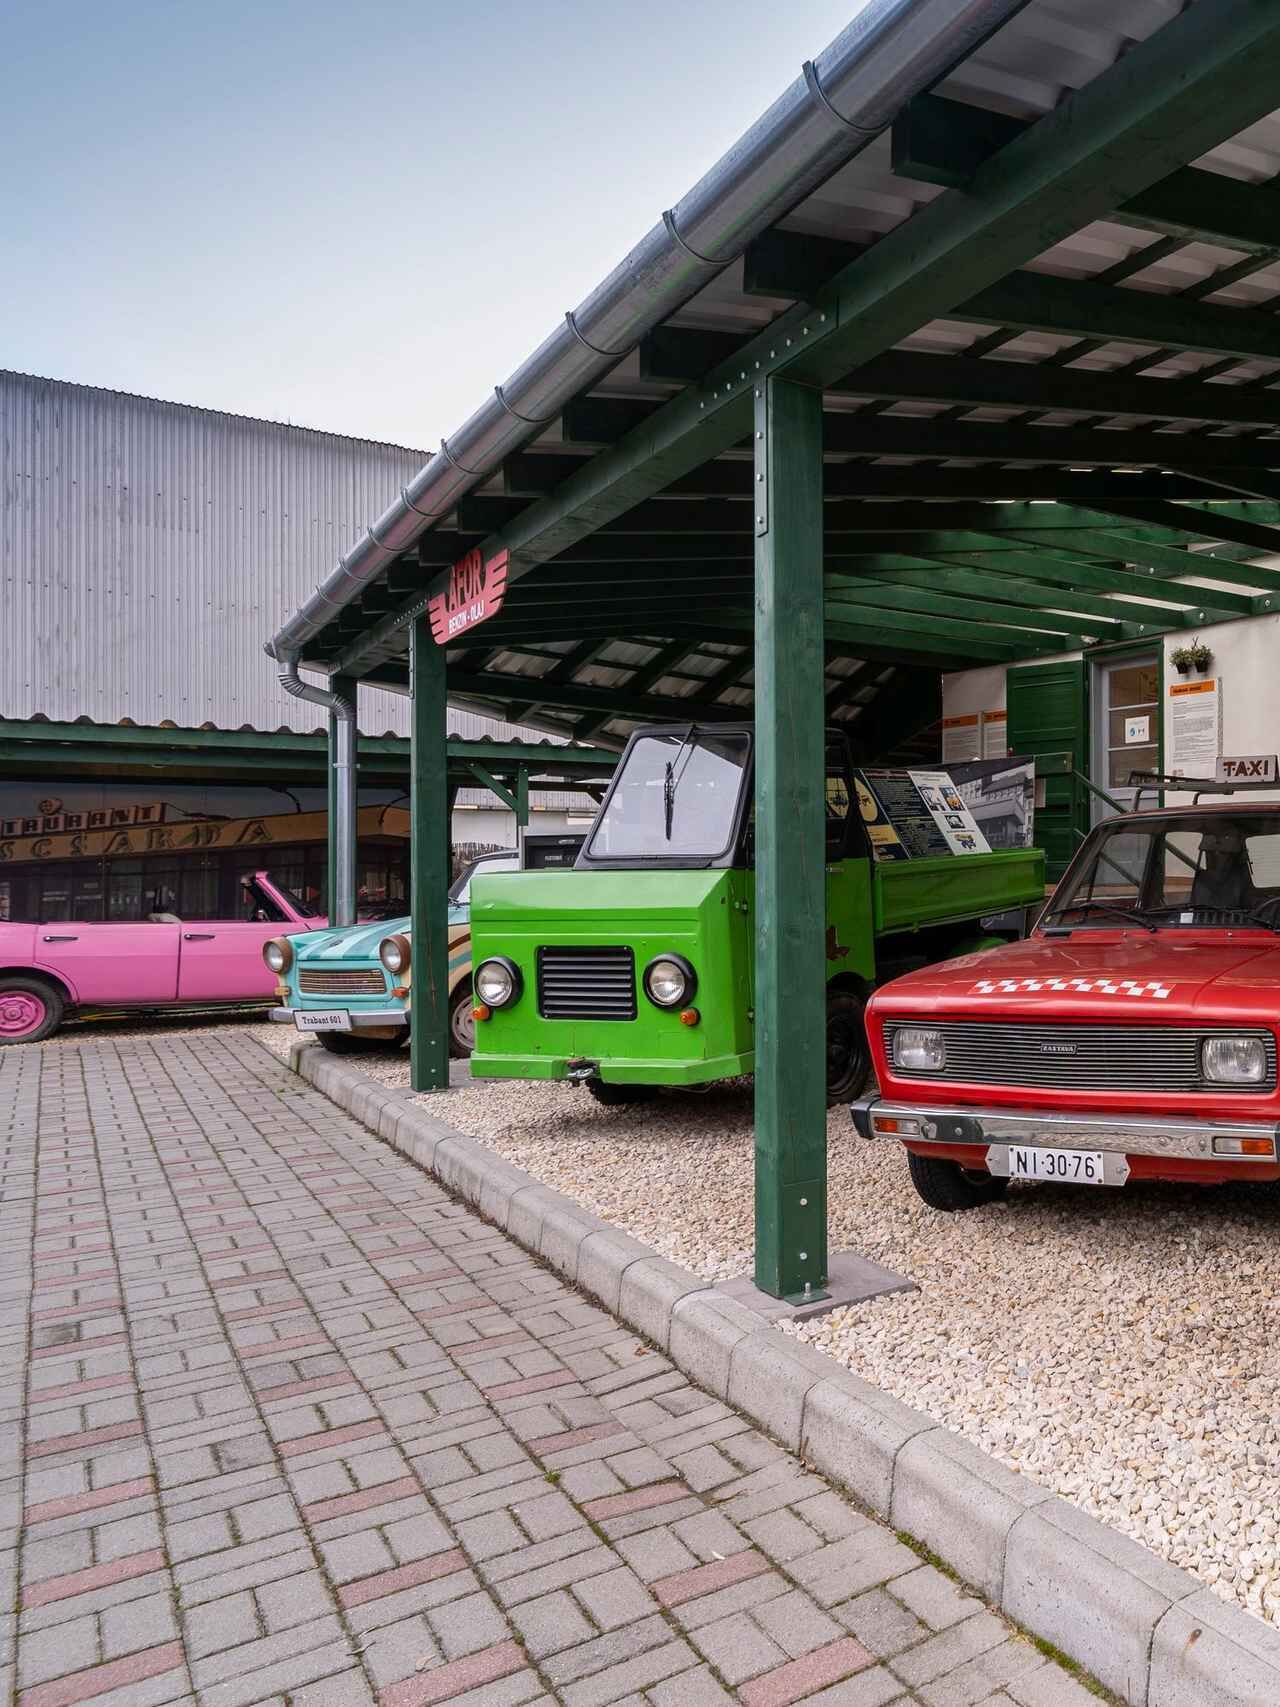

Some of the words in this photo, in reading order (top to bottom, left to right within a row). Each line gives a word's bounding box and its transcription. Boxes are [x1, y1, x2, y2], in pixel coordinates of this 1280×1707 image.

[449, 549, 483, 612] AFOR
[301, 1015, 329, 1025] Trabant
[330, 1015, 342, 1024] 601
